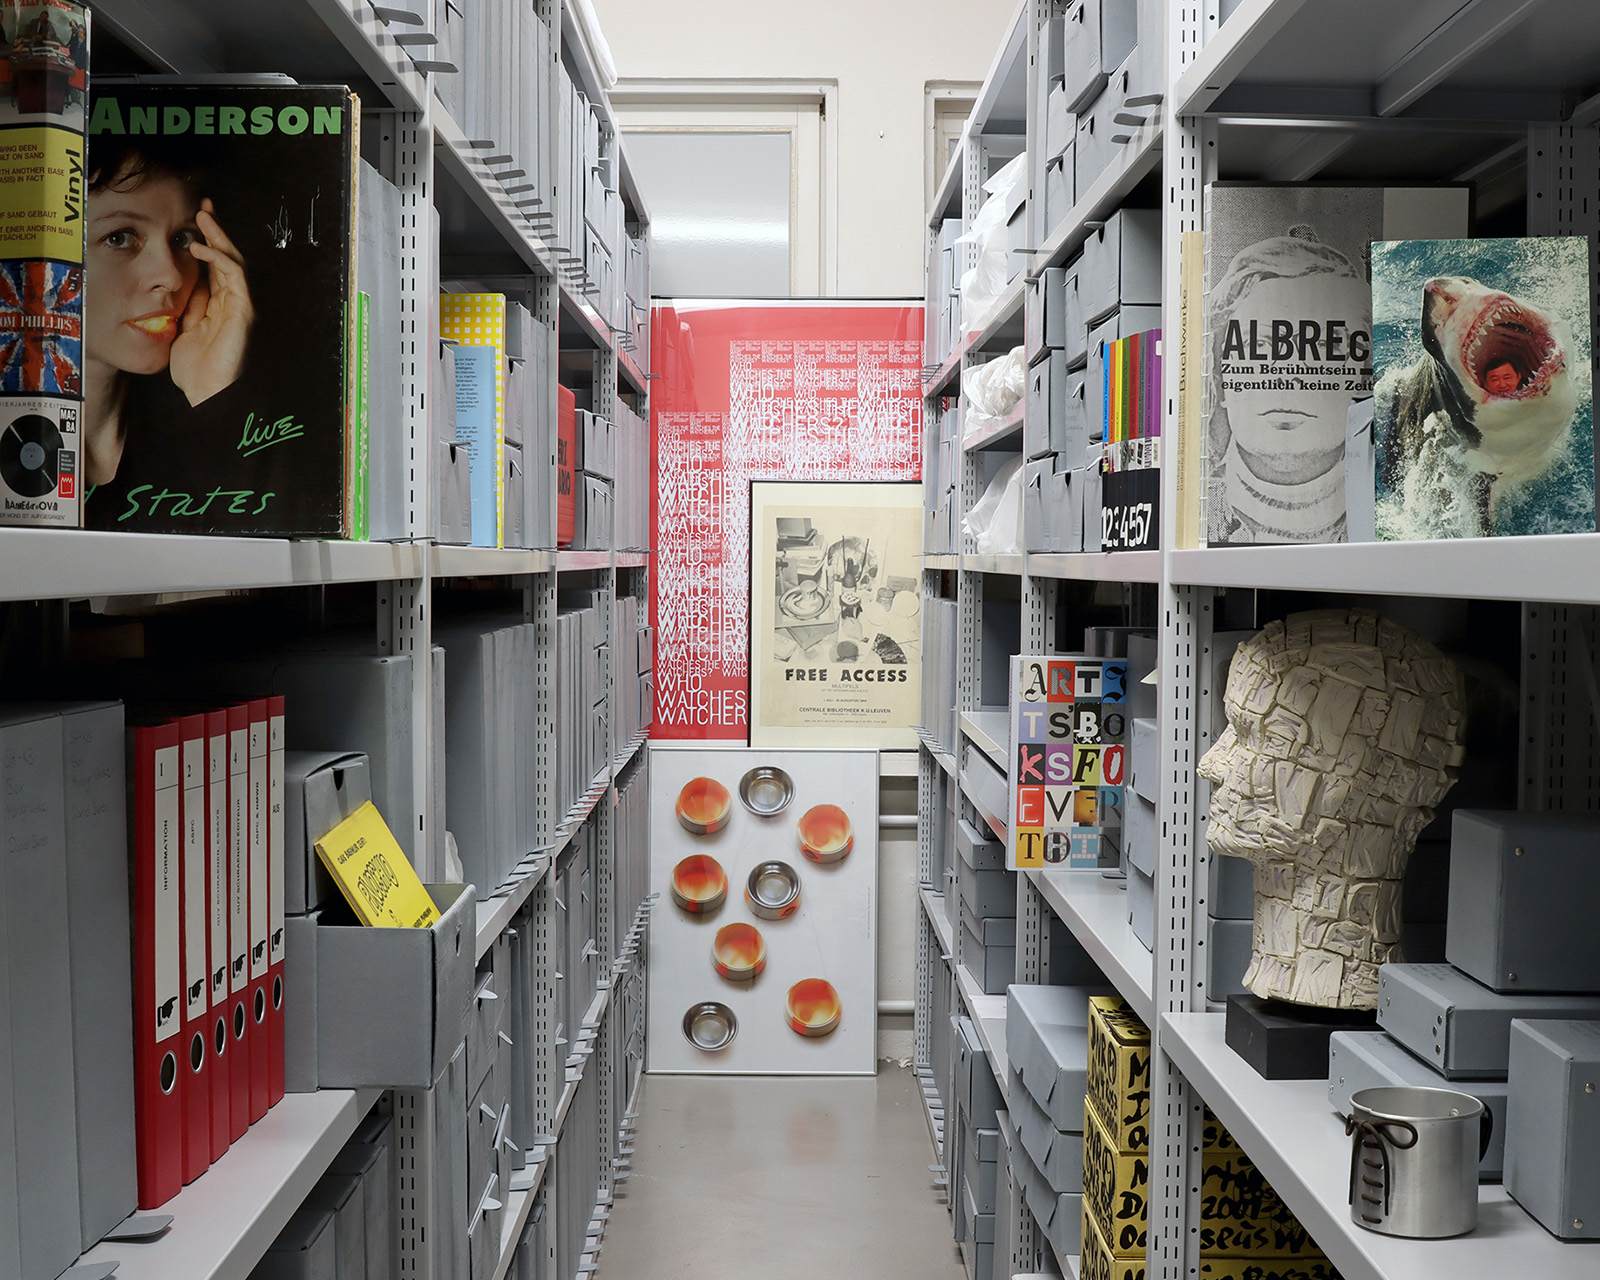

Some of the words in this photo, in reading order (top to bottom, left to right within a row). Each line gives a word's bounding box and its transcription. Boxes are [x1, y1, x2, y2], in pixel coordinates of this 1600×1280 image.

[89, 97, 342, 135] ANDERSON
[24, 152, 44, 160] SAND
[12, 166, 45, 174] ANOTHER
[64, 148, 83, 222] Vinyl
[26, 225, 56, 233] ANDERN
[58, 228, 74, 236] BASIS
[20, 316, 72, 331] PHILLIPS
[1179, 290, 1188, 392] Buchwerke
[730, 362, 752, 371] WHO
[794, 362, 816, 371] WHO
[858, 362, 880, 371] WHO
[1221, 364, 1255, 375] Zum
[1260, 364, 1356, 375] Berühmtsein
[1221, 379, 1294, 392] eigentlich
[1299, 379, 1340, 391] keine
[1345, 380, 1374, 391] Zeit
[794, 390, 816, 399] WHO
[60, 408, 76, 420] MAC
[66, 421, 76, 432] BA
[237, 412, 304, 450] live
[658, 433, 680, 442] WHO
[118, 484, 276, 522] States
[658, 533, 701, 542] WATCHES
[704, 533, 720, 542] THE
[657, 660, 701, 669] WATCHES
[704, 660, 720, 669] THE
[658, 668, 713, 677] WATCHERS?
[785, 668, 828, 681] FREE
[840, 669, 908, 682] ACCESS
[658, 674, 702, 692] WHO
[658, 690, 746, 709] WATCHES
[159, 762, 163, 776] 1
